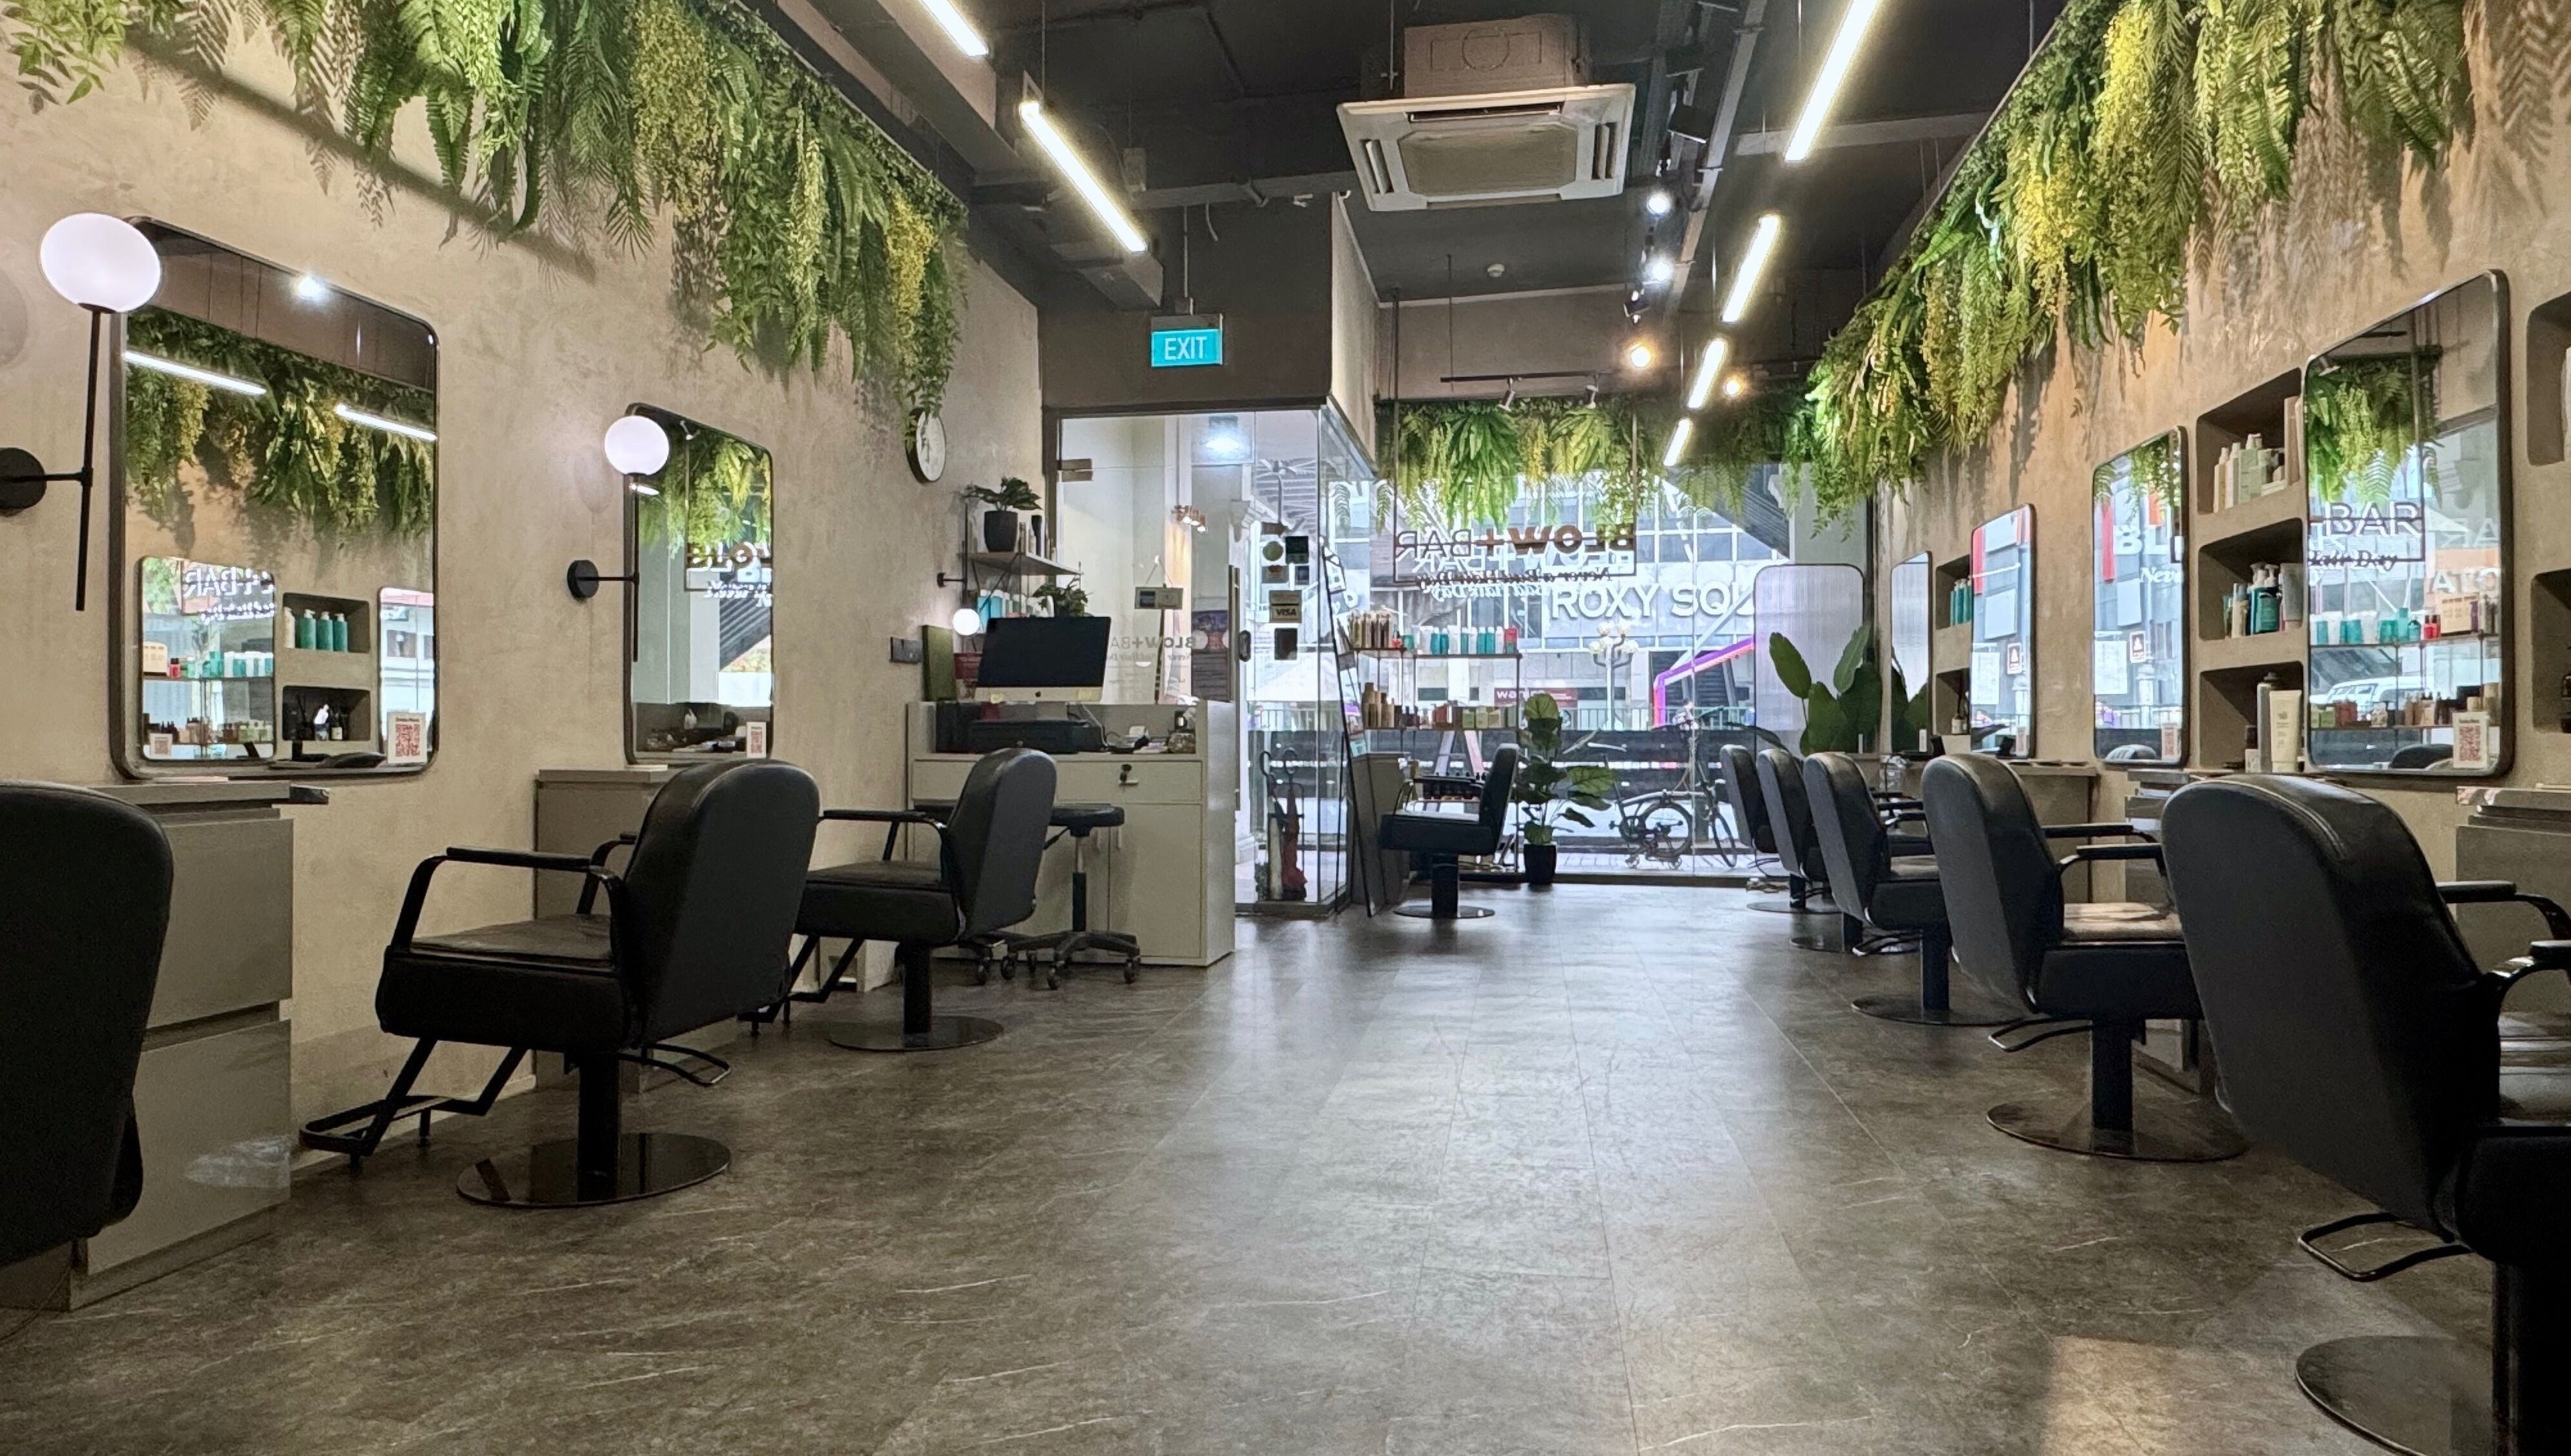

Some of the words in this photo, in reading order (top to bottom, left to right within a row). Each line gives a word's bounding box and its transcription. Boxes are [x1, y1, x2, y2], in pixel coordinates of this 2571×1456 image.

[1164, 336, 1207, 360] EXIT
[1275, 608, 1297, 617] VISA
[1551, 582, 1659, 619] ROXY
